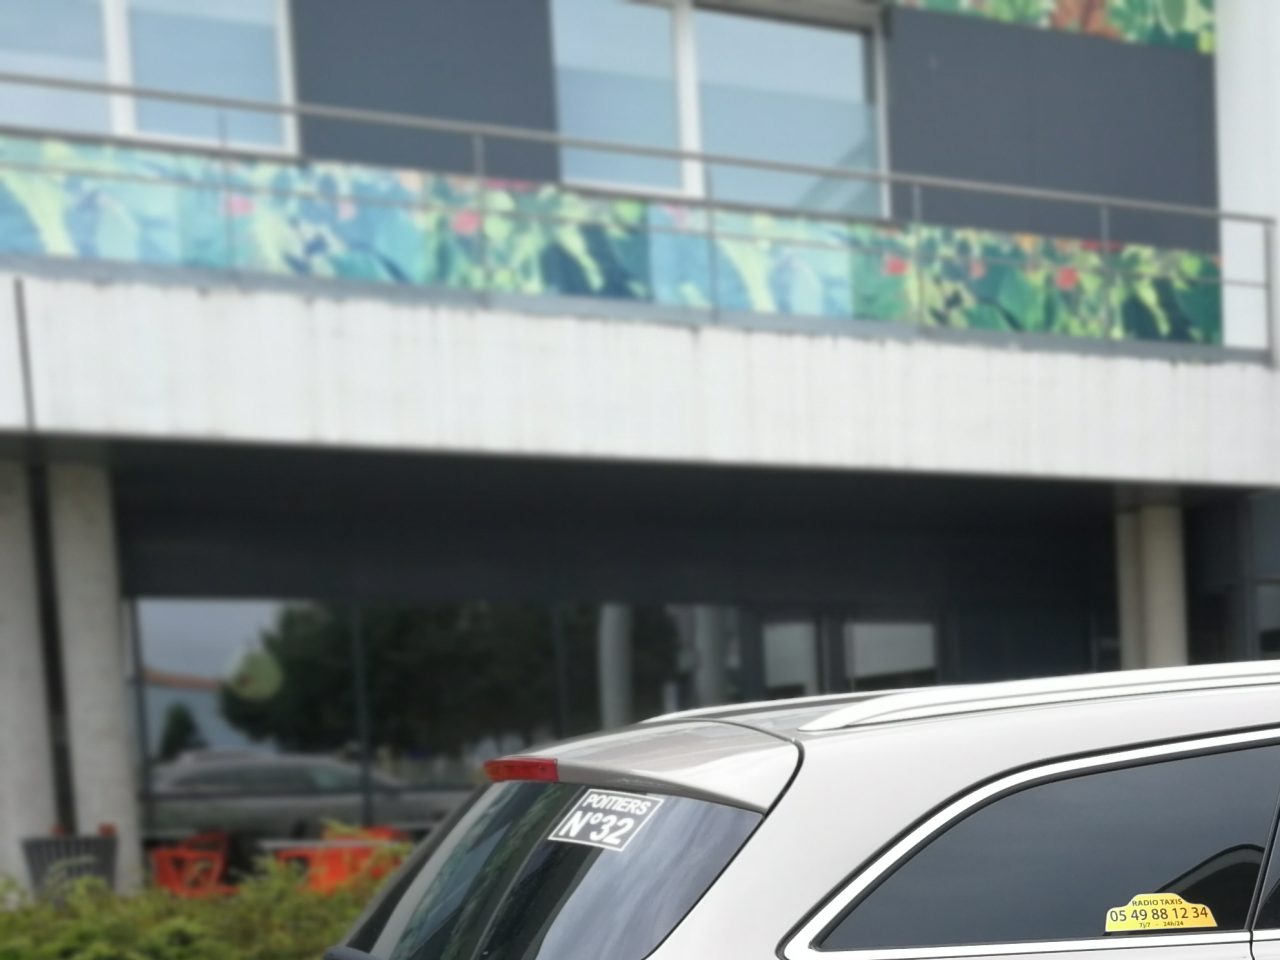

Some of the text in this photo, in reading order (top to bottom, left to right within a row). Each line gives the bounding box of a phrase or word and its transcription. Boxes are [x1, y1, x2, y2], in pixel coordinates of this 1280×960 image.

[582, 793, 652, 815] POITIERS
[1110, 906, 1208, 922] 05 49 88 12 34
